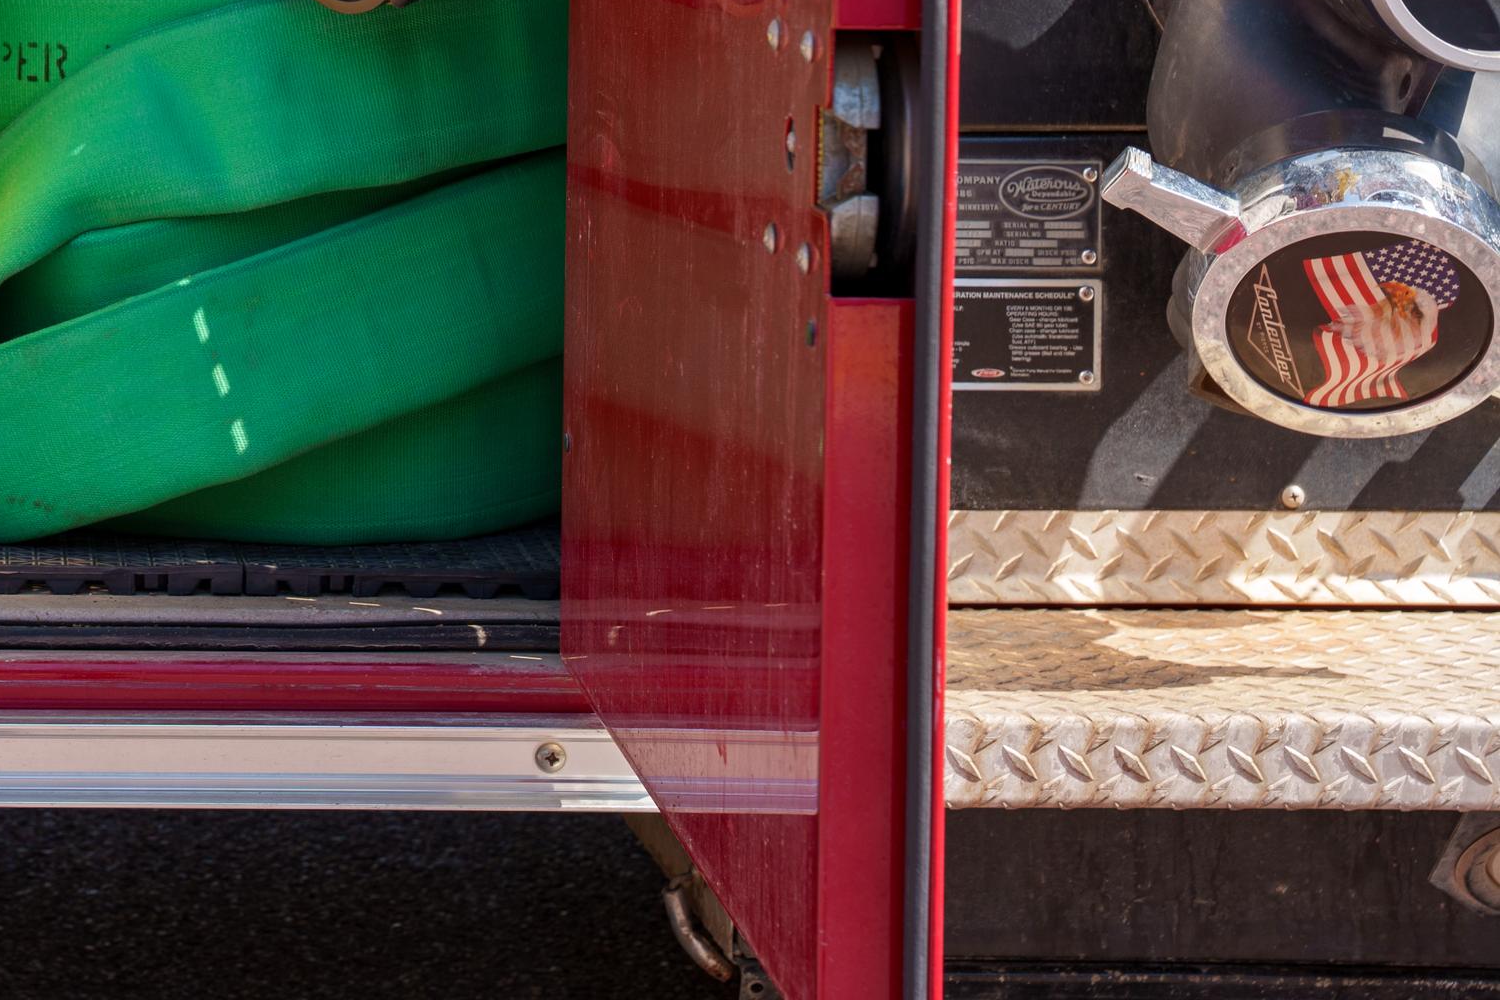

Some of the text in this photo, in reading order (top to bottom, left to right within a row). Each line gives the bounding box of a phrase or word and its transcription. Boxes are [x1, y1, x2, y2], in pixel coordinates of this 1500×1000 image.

[956, 175, 1001, 185] OMPANY
[1007, 176, 1081, 198] Waterous
[1040, 202, 1082, 211] CENTURY
[1003, 221, 1028, 229] SERIAL
[982, 291, 1034, 299] MAINTENANCE
[1253, 284, 1292, 383] Contender
